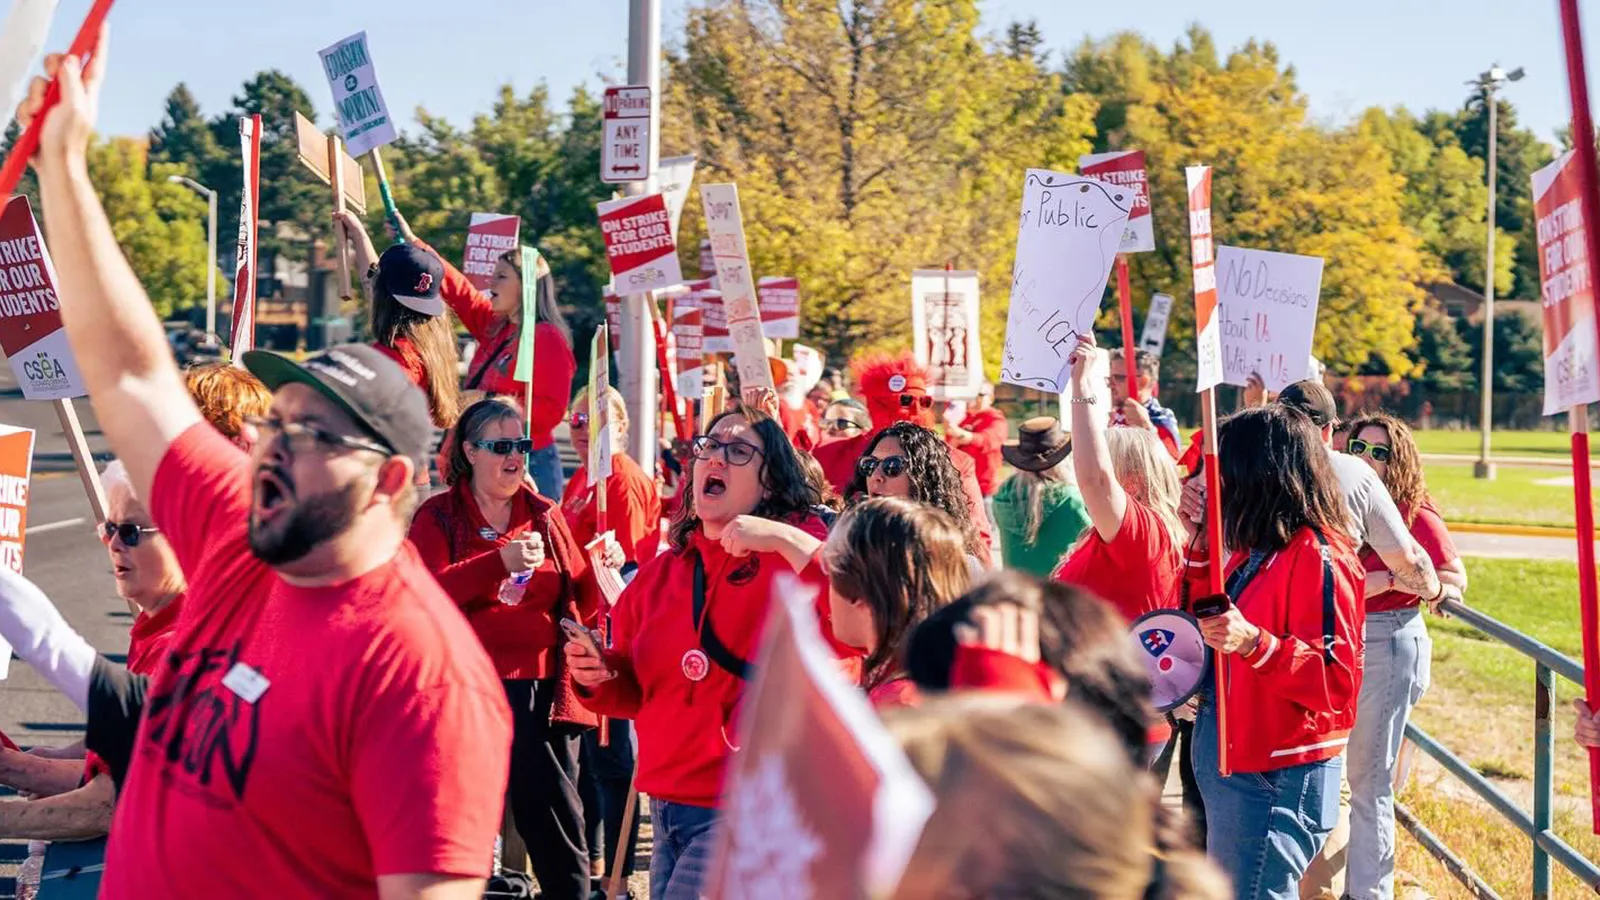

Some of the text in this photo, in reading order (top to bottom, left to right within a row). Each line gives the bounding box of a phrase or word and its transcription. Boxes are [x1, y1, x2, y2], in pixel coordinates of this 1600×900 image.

[604, 94, 650, 113] NO PARKING
[616, 125, 639, 140] ANY
[614, 143, 640, 158] TIME
[1038, 190, 1099, 229] Public
[601, 209, 668, 233] ON STRIKE
[467, 233, 481, 247] ON
[611, 224, 666, 244] FOR OUR
[470, 247, 487, 262] FOR
[608, 236, 673, 257] STUDENTS
[9, 263, 46, 290] OUR
[1224, 254, 1252, 297] No
[1253, 260, 1309, 308] Decisions
[1037, 308, 1080, 359] ICE
[1255, 311, 1270, 342] Us
[1269, 352, 1288, 383] Us
